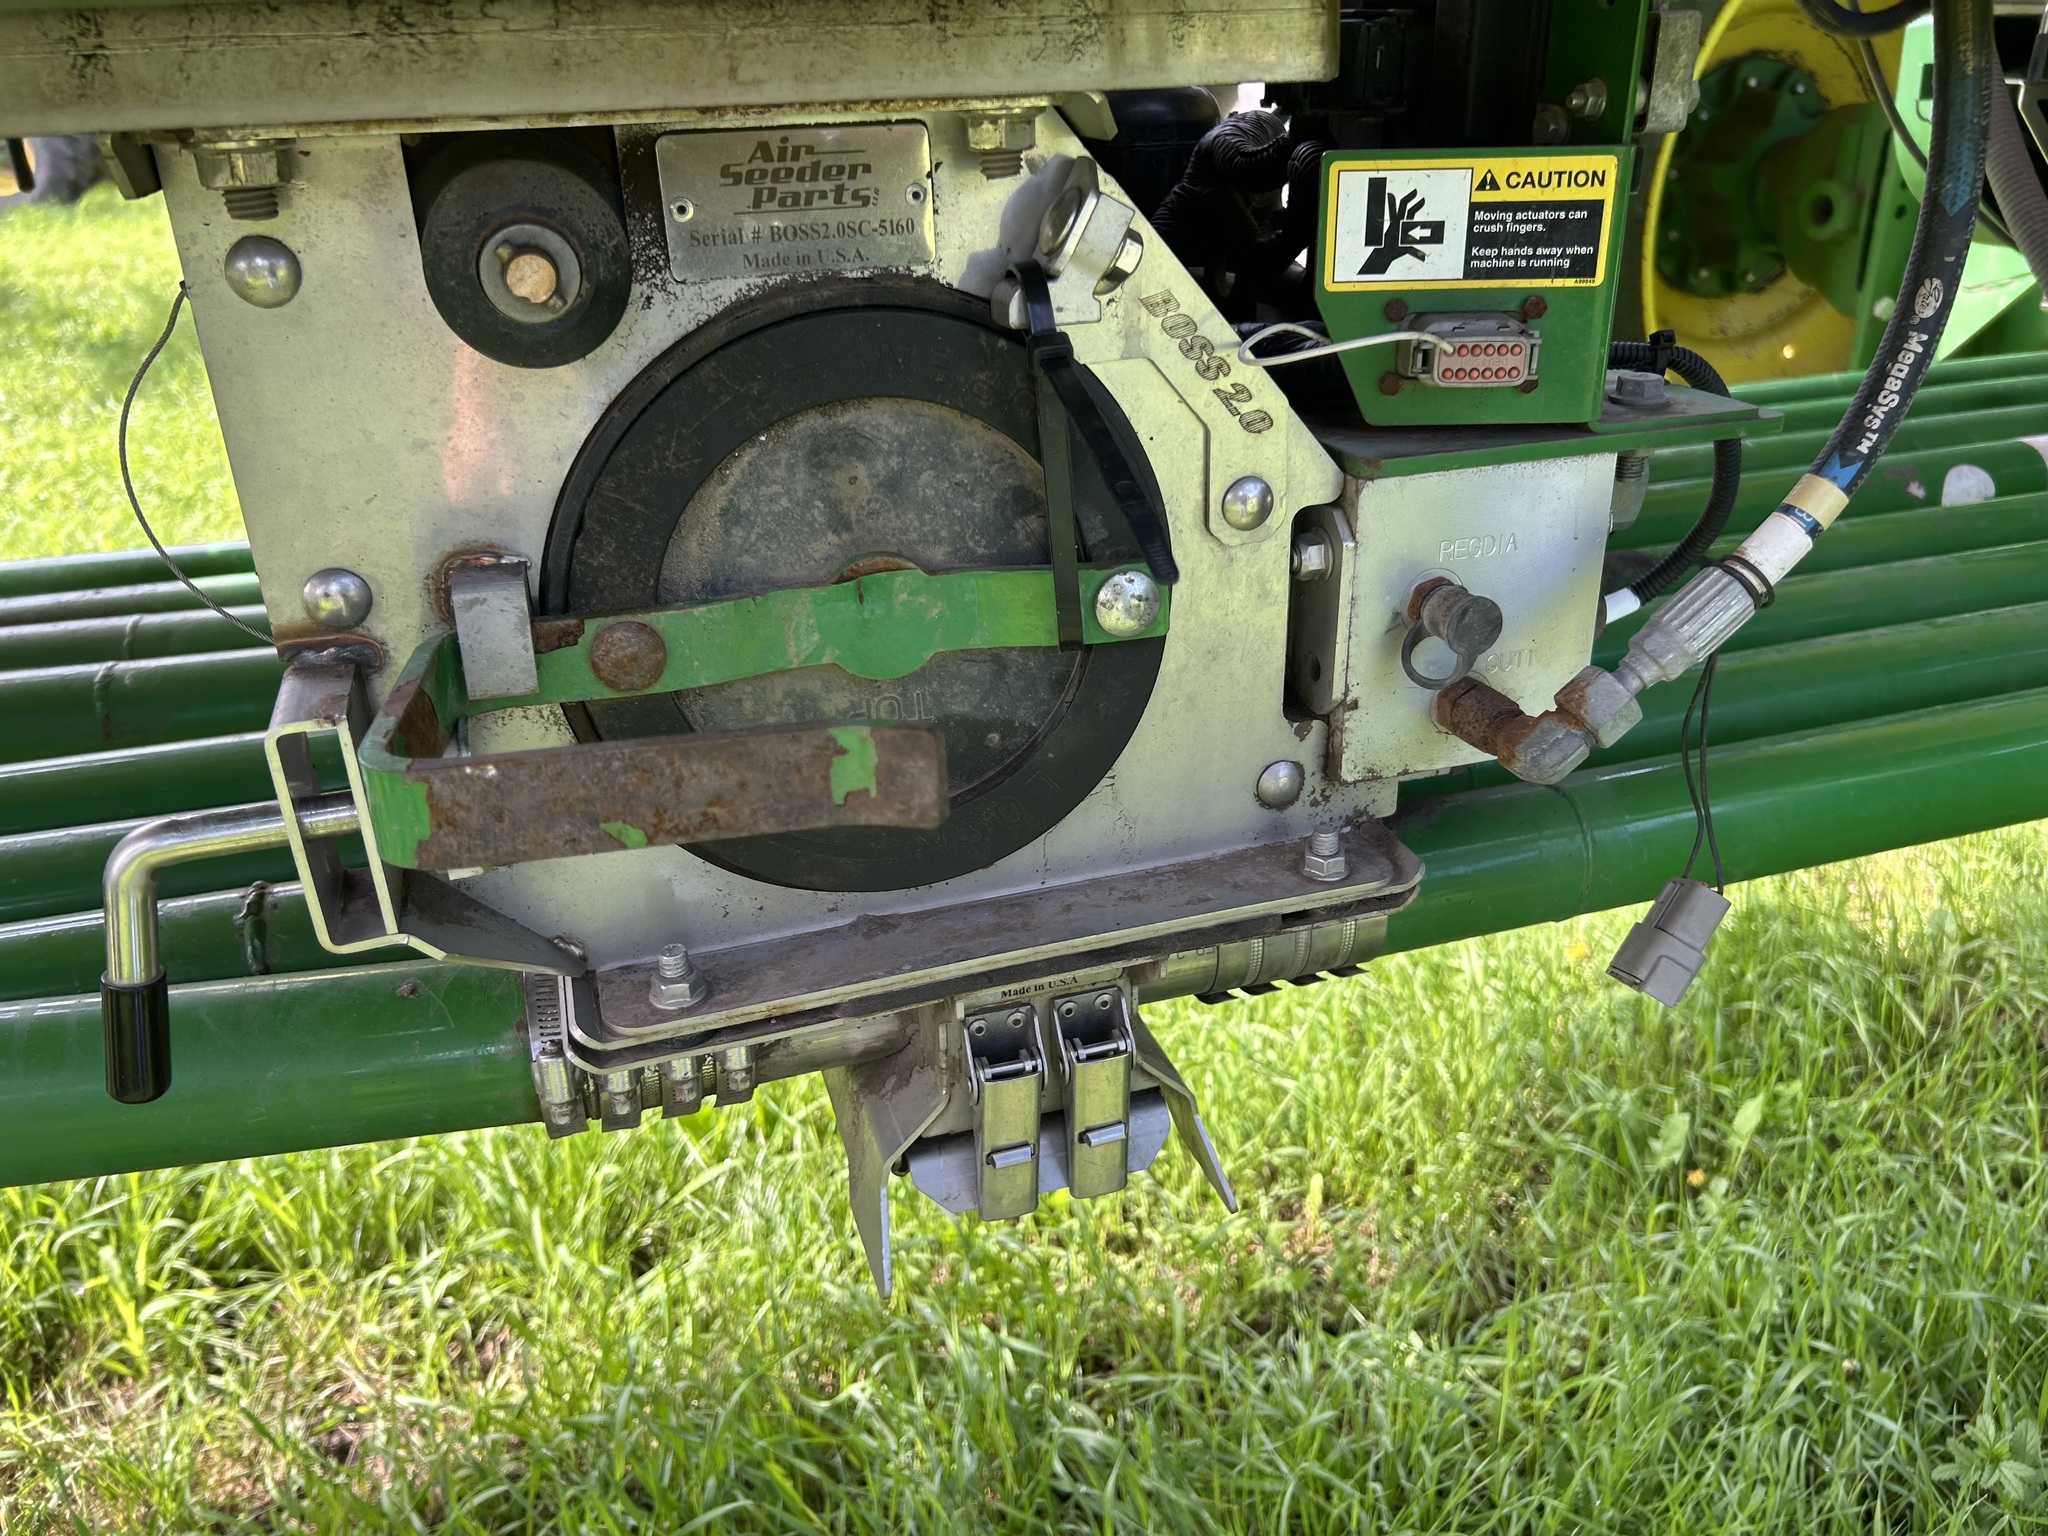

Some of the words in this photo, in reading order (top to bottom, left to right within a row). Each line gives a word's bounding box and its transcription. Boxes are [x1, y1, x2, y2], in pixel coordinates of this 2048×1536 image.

[747, 136, 825, 165] Air
[719, 160, 872, 187] Seeder
[1505, 169, 1606, 189] CAUTION
[750, 184, 872, 210] Parts
[1474, 210, 1513, 223] Moving
[1515, 209, 1565, 220] actuators
[1568, 210, 1588, 219] can
[689, 225, 744, 248] Serial
[751, 225, 762, 245] #
[769, 217, 916, 244] BOSS2.0SC-5160
[1473, 223, 1503, 233] crush
[1506, 223, 1546, 234] fingers.
[742, 252, 790, 270] Made
[796, 250, 811, 266] in
[817, 247, 870, 264] U.S.A.
[1470, 258, 1514, 268] machine
[1517, 258, 1527, 267] is
[1529, 257, 1570, 269] running
[1471, 246, 1498, 258] Keep
[1500, 245, 1533, 256] hands
[1535, 247, 1563, 257] away
[1565, 245, 1594, 255] when
[1138, 288, 1231, 381] BOSS
[1864, 330, 1929, 431] MegaSys
[1000, 985, 1032, 998] Made
[1034, 982, 1045, 992] in
